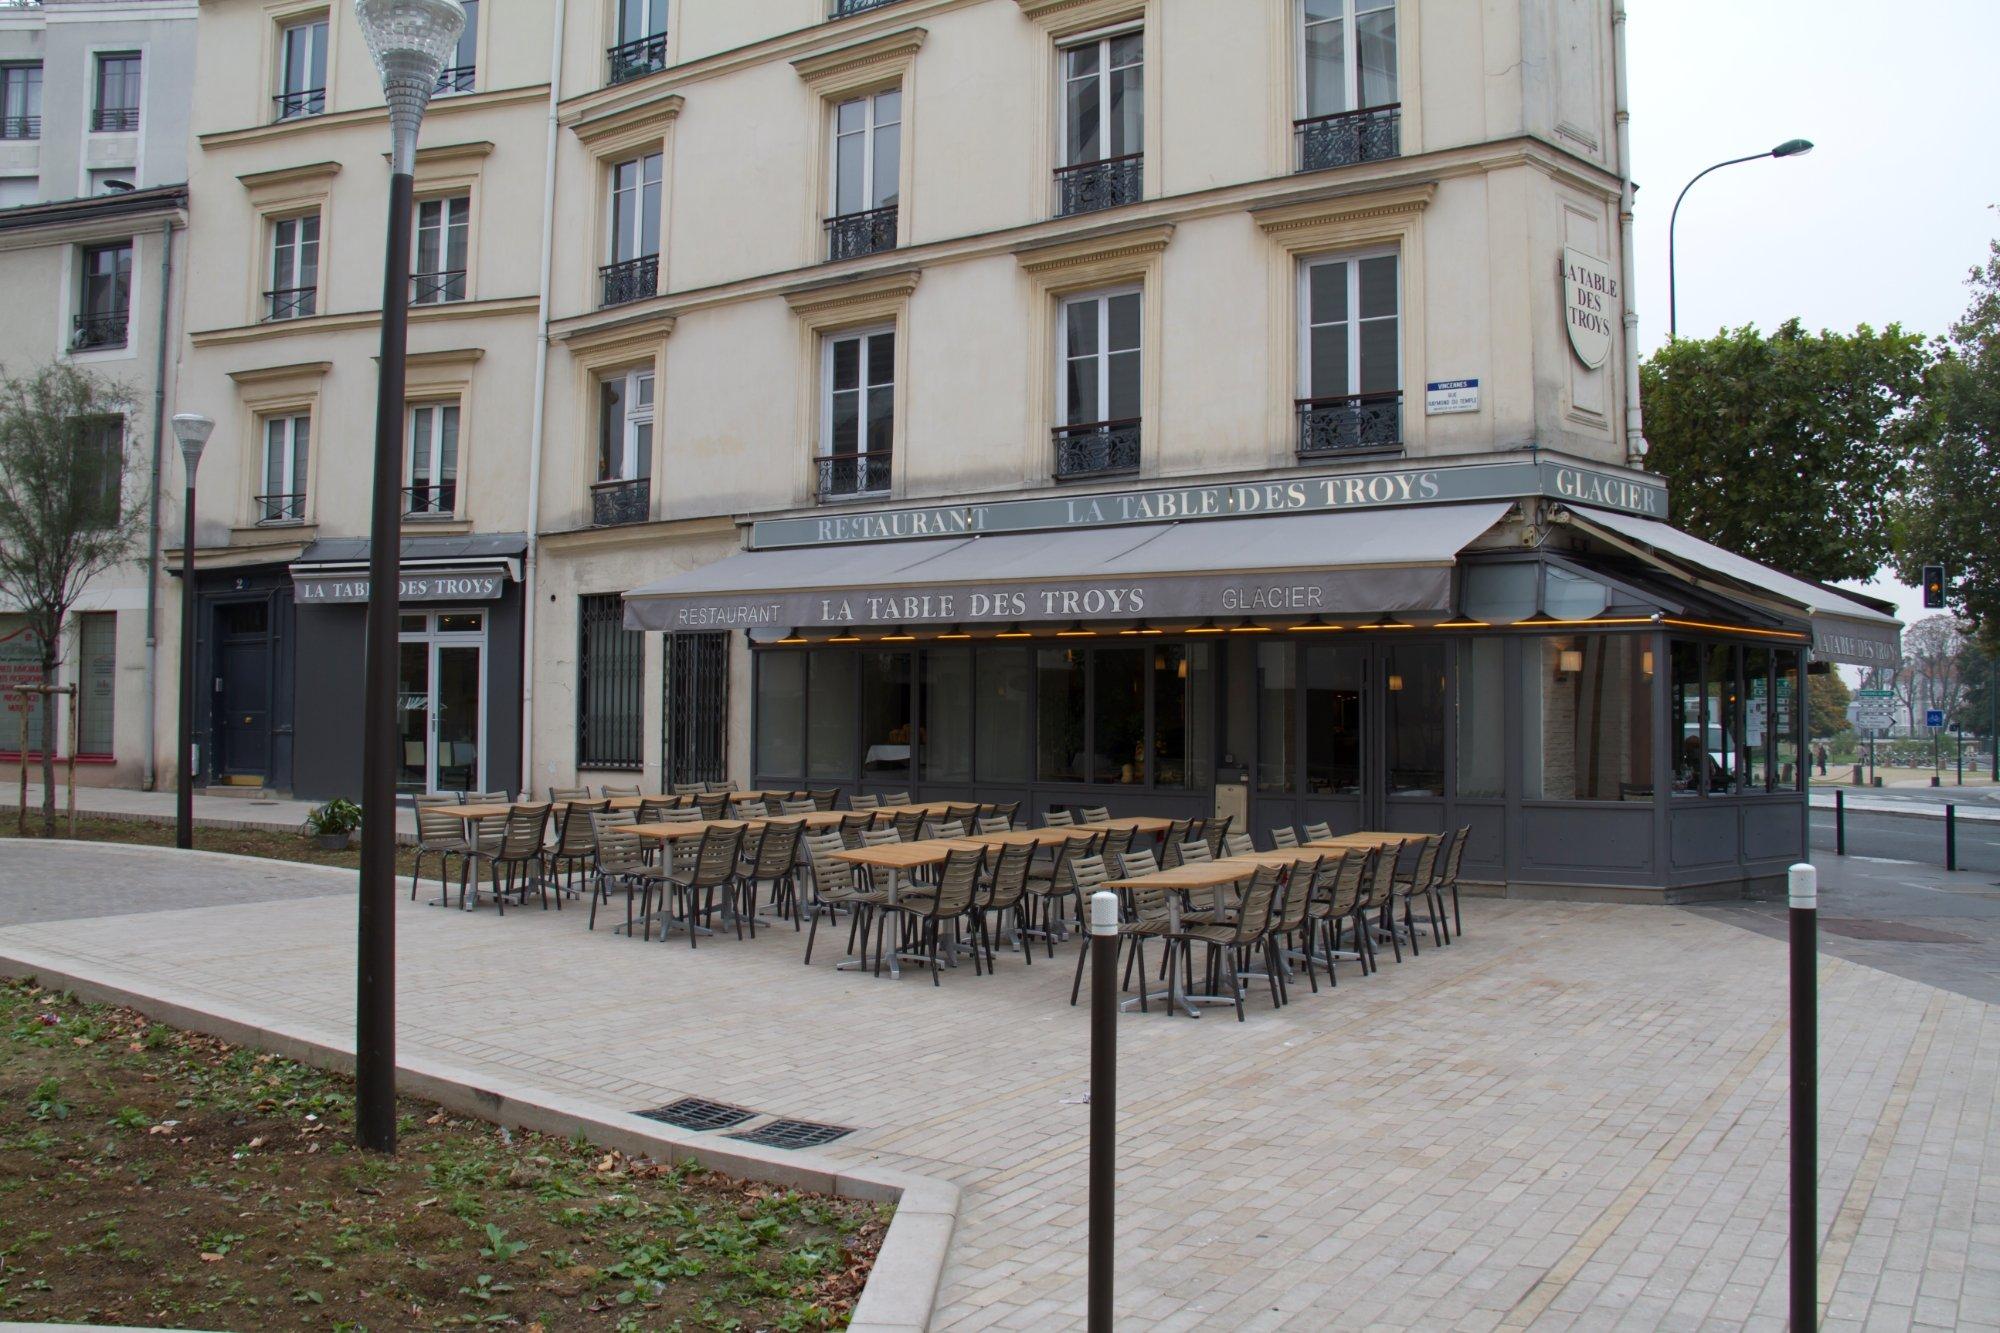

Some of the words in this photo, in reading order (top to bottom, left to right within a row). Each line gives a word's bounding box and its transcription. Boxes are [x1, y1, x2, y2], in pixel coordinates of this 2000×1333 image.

[1577, 266, 1617, 298] TABLE
[1577, 287, 1602, 312] DES
[1569, 306, 1610, 336] TROYS
[1066, 498, 1105, 524] LA
[1116, 488, 1219, 520] TABLE
[1236, 480, 1306, 513] DES
[1320, 473, 1440, 506] TROYS
[1556, 468, 1656, 513] GLACIER
[818, 507, 989, 541] RESTAURANT
[236, 578, 244, 590] 2
[304, 584, 324, 598] LA
[332, 582, 370, 597] TAB
[434, 578, 493, 594] TROYS
[1222, 586, 1323, 609] GLACIER
[678, 605, 781, 625] RESTAURANT
[820, 600, 855, 622] LA
[866, 595, 956, 620] TABLE
[969, 592, 1027, 616] DES
[1040, 588, 1146, 614] TROYS
[1829, 634, 1856, 656] TABLE
[1857, 640, 1874, 659] DES
